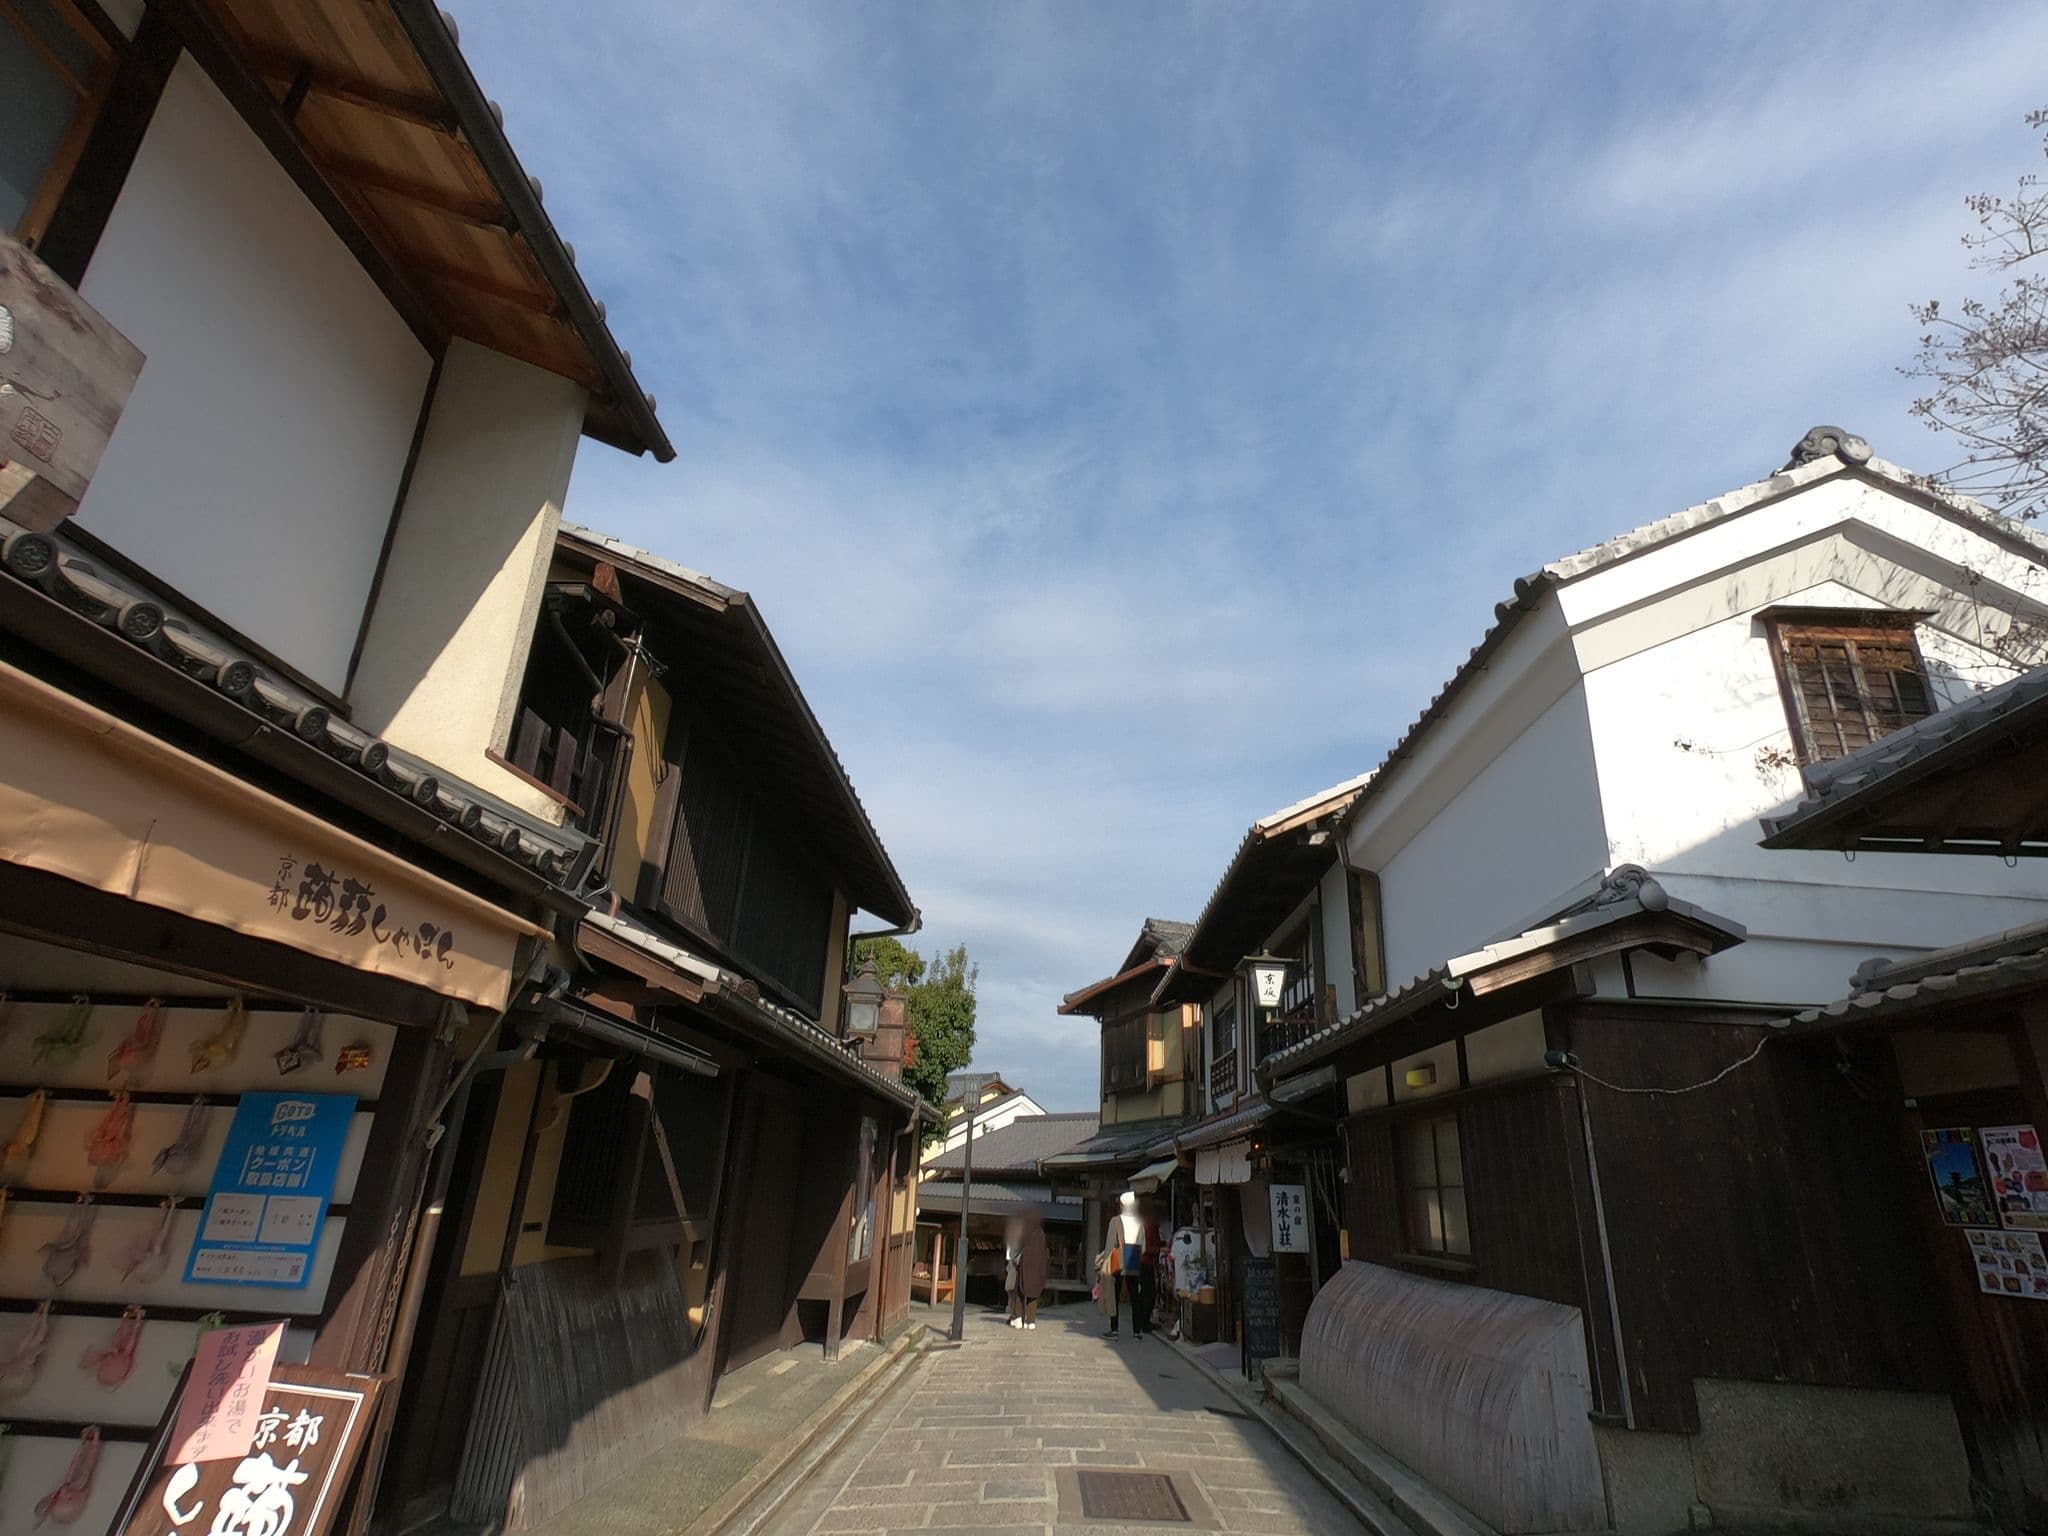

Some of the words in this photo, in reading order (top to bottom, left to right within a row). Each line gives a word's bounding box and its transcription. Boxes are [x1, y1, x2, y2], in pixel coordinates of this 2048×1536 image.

[268, 855, 298, 913] 京都
[250, 1157, 306, 1171] クーポン
[1276, 1191, 1292, 1246] 清水山荘
[252, 1406, 324, 1456] 京都
